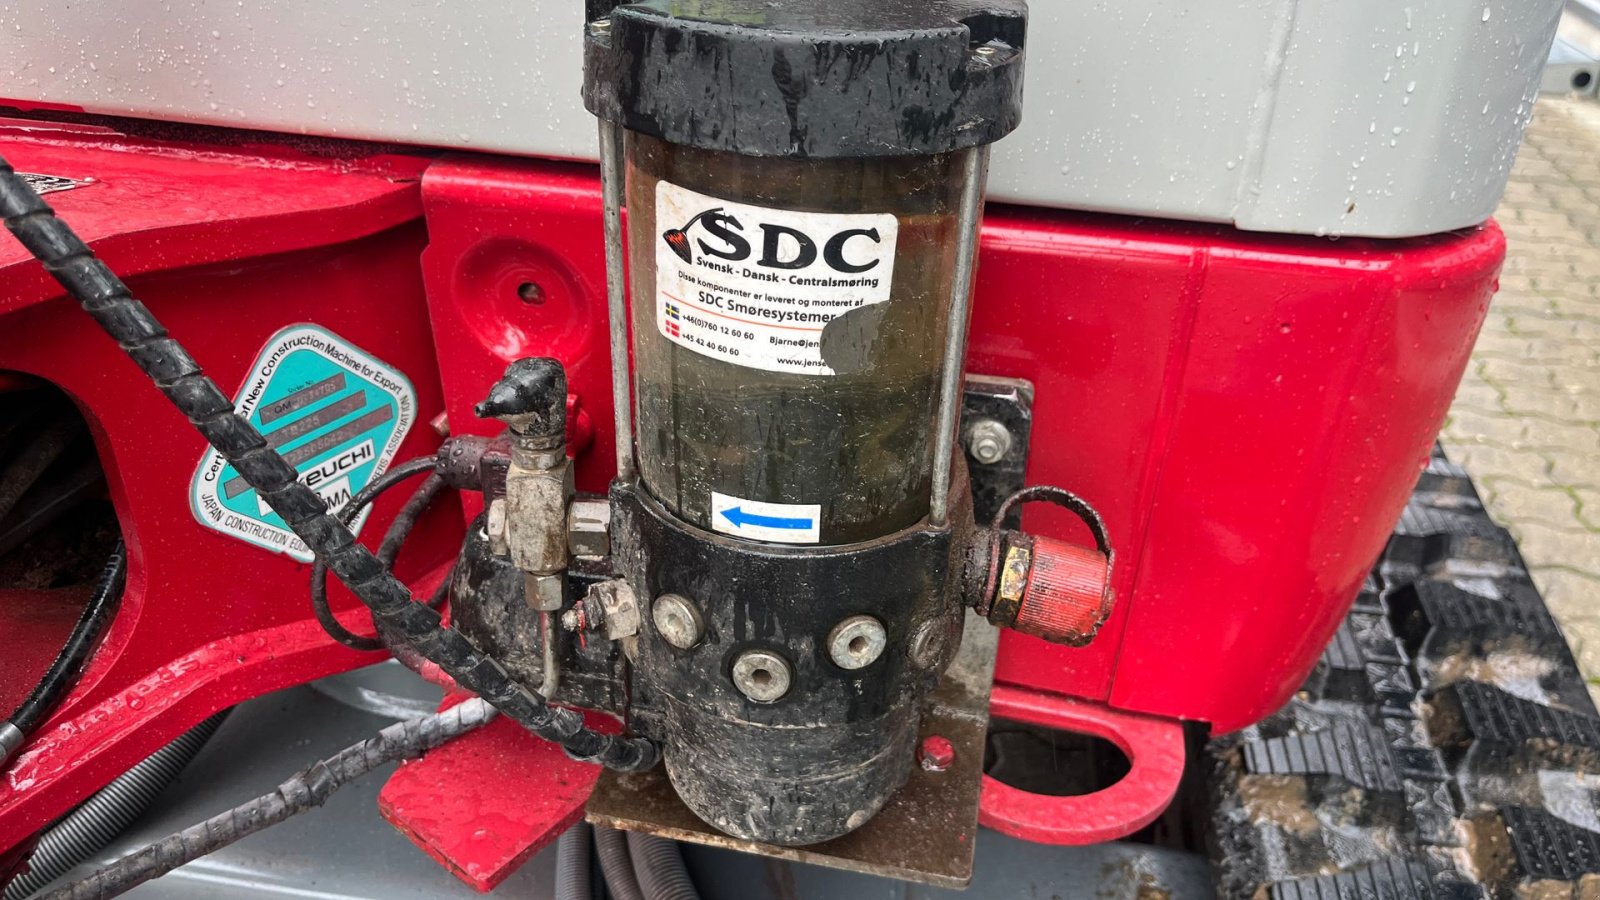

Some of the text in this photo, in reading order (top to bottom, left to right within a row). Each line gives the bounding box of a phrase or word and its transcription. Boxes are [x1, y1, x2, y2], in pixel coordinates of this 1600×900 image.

[697, 208, 881, 273] SDC
[678, 270, 696, 284] Disse
[697, 277, 751, 298] komponenter
[765, 293, 795, 305] leveret
[797, 299, 809, 307] og
[812, 299, 852, 307] monteret
[855, 298, 864, 306] af
[696, 257, 734, 275] Svensk
[742, 268, 779, 283] Dansk
[788, 275, 879, 288] Centralsmøring
[698, 291, 836, 323] SDC Smøresystemer
[682, 314, 755, 341] +46(0)760 12 60 60
[682, 333, 740, 356] +45 42 40 60 60
[769, 336, 821, 349] Bjarne@jen
[203, 452, 226, 482] Cert
[246, 378, 265, 405] New
[261, 335, 325, 376] Construction
[324, 344, 362, 371] Machine
[361, 364, 375, 377] for
[373, 371, 403, 394] Export
[386, 394, 410, 457] ASSOCIATION
[201, 494, 225, 521] JAPAN
[224, 515, 288, 546] CONSTRUCTION
